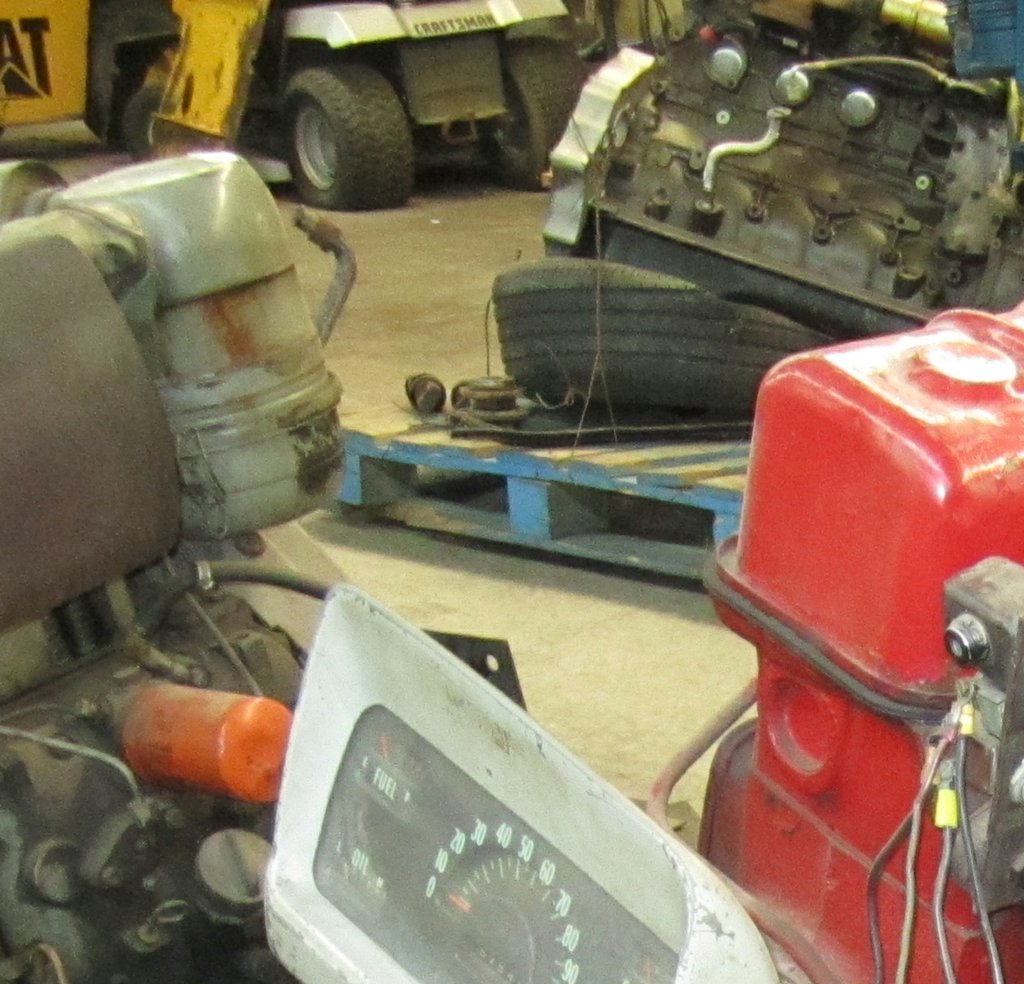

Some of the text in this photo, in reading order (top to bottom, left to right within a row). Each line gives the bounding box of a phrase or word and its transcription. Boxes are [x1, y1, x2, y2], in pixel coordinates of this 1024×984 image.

[414, 12, 497, 35] CRAFTSMAN
[373, 767, 397, 801] FUEL
[450, 828, 466, 855] 20
[471, 817, 487, 846] 30
[496, 822, 513, 848] 40
[434, 848, 448, 873] 10
[517, 834, 534, 862] 50
[351, 848, 369, 876] OIL
[539, 859, 556, 885] 60
[425, 876, 437, 898] 0
[556, 889, 572, 917] 70
[561, 924, 580, 951] 80
